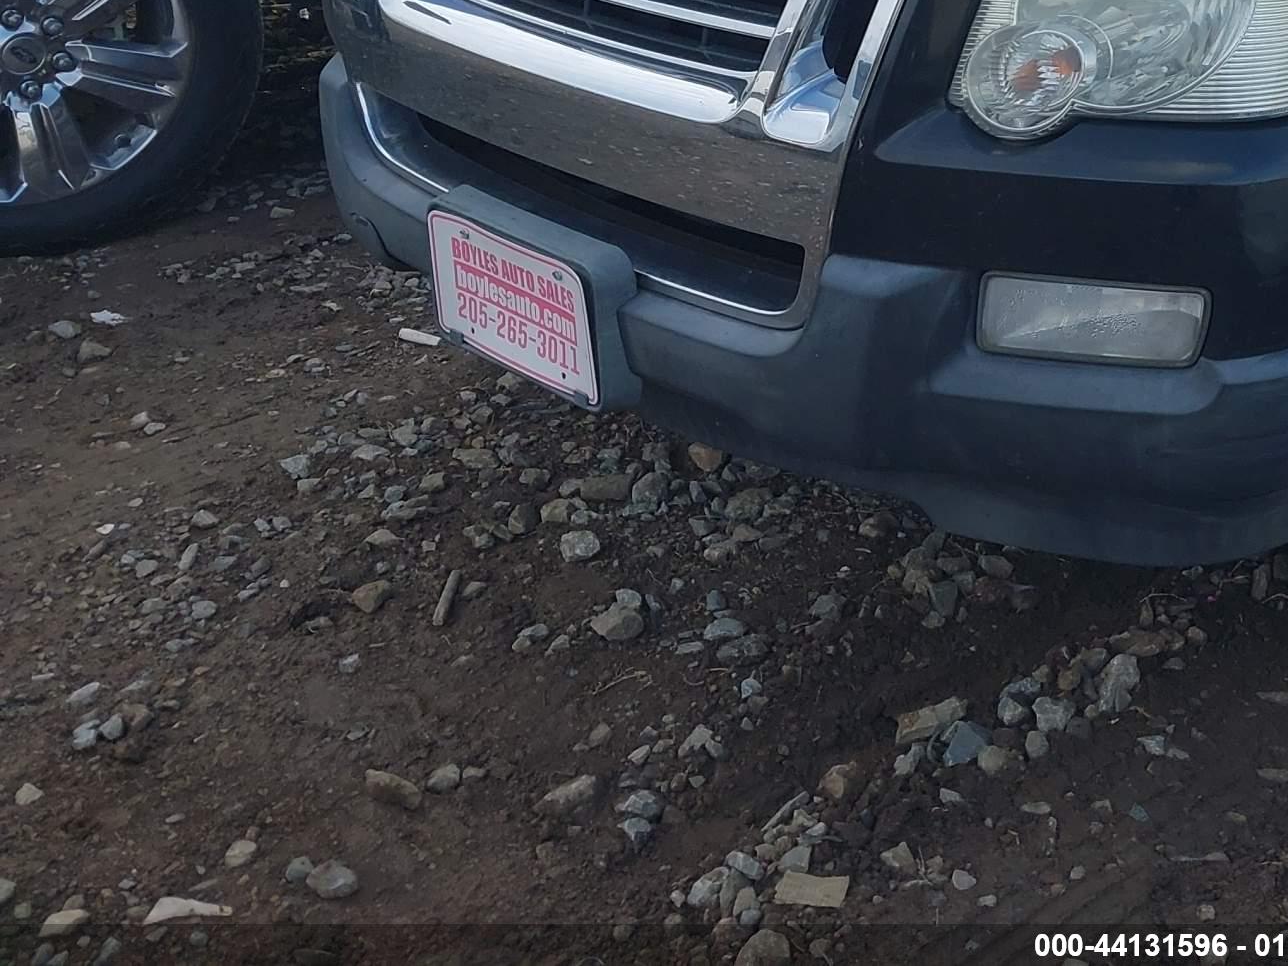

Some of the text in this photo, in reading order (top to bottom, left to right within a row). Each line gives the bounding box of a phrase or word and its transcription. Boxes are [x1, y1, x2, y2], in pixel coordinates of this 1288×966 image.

[451, 236, 575, 313] BOYLES AUTO SALES
[457, 267, 576, 344] boylesauto.com
[457, 292, 580, 375] 205-265-3011
